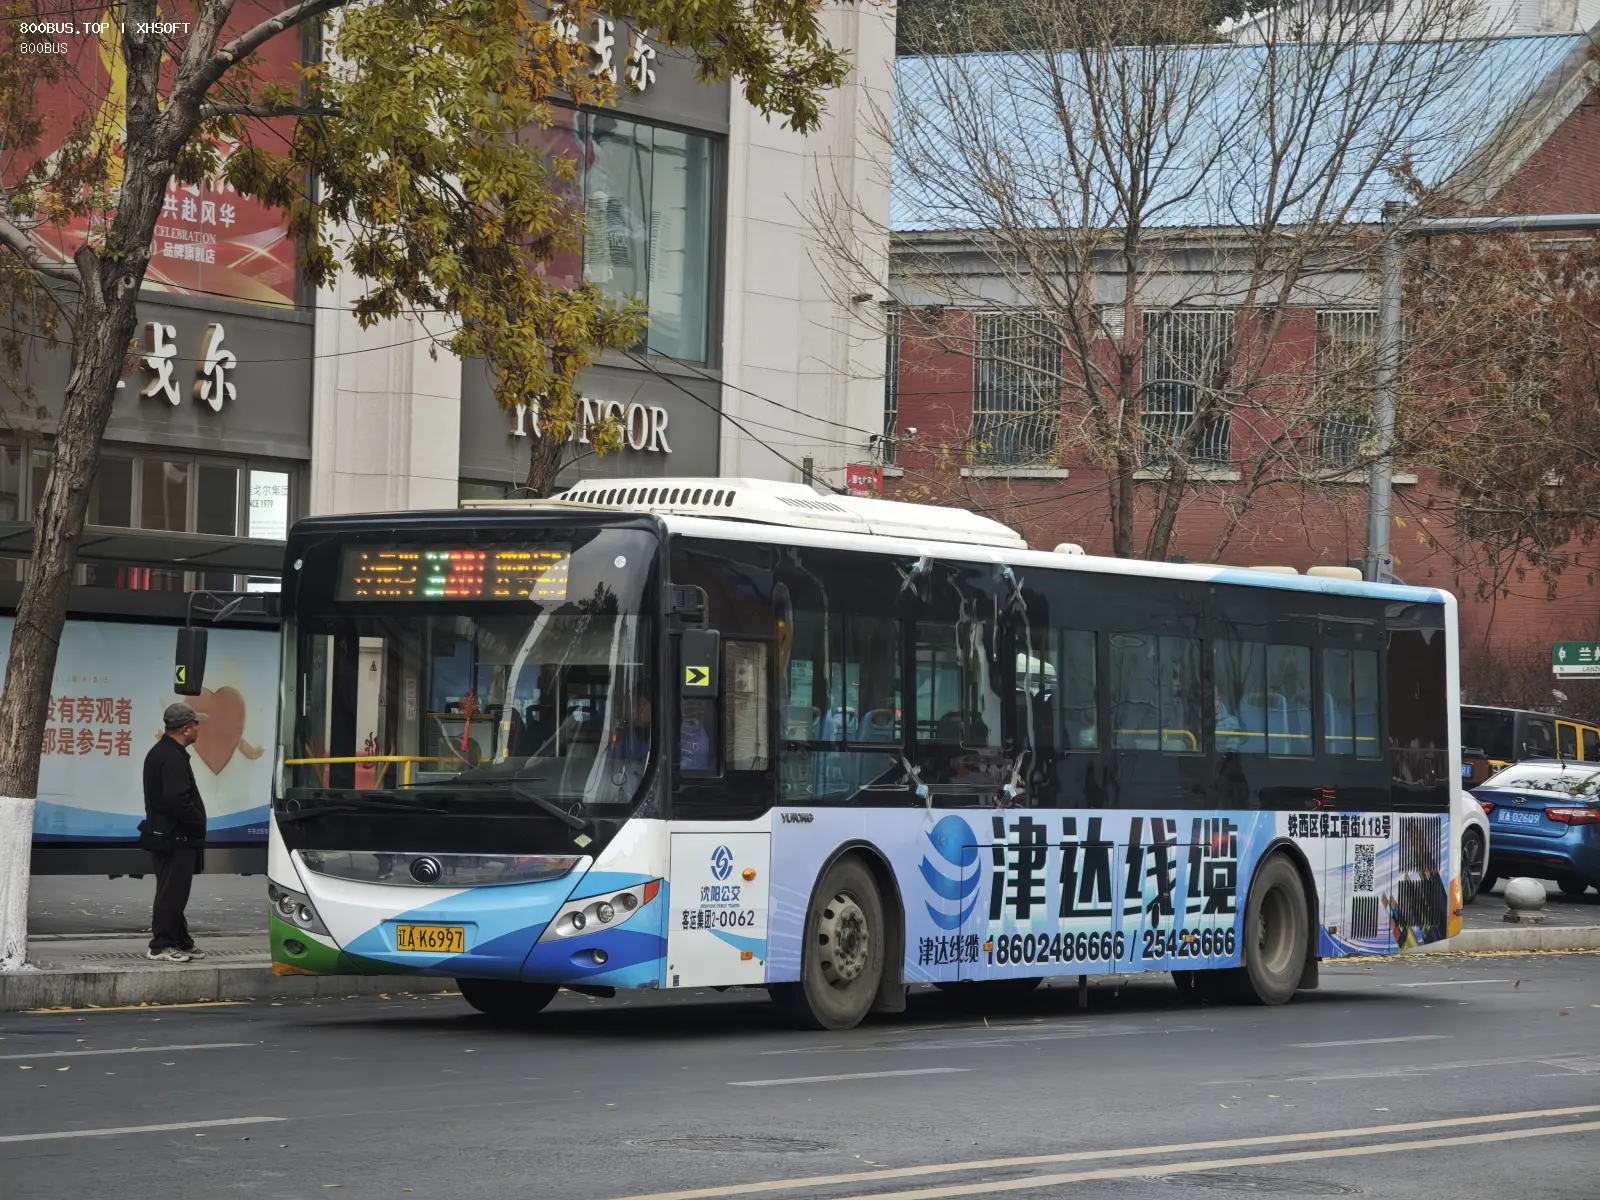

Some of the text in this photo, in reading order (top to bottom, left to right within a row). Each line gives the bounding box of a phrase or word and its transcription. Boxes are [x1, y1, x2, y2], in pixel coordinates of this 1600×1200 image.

[162, 194, 236, 229] 共赴风华
[154, 225, 216, 245] CELEBRATION
[163, 241, 216, 264] 品牌旗舰店
[116, 321, 237, 412] 戈尔
[509, 390, 672, 453] YNGOR
[250, 484, 288, 497] 戈尔集团
[261, 499, 273, 508] 1979
[1288, 813, 1391, 839] 铁西区保工南街118号
[988, 816, 1238, 920] 津达线缆
[700, 885, 740, 901] 沈阳公交
[918, 934, 979, 966] 津达线缆
[987, 931, 1124, 966] 18602486666
[1143, 927, 1235, 960] 25426666
